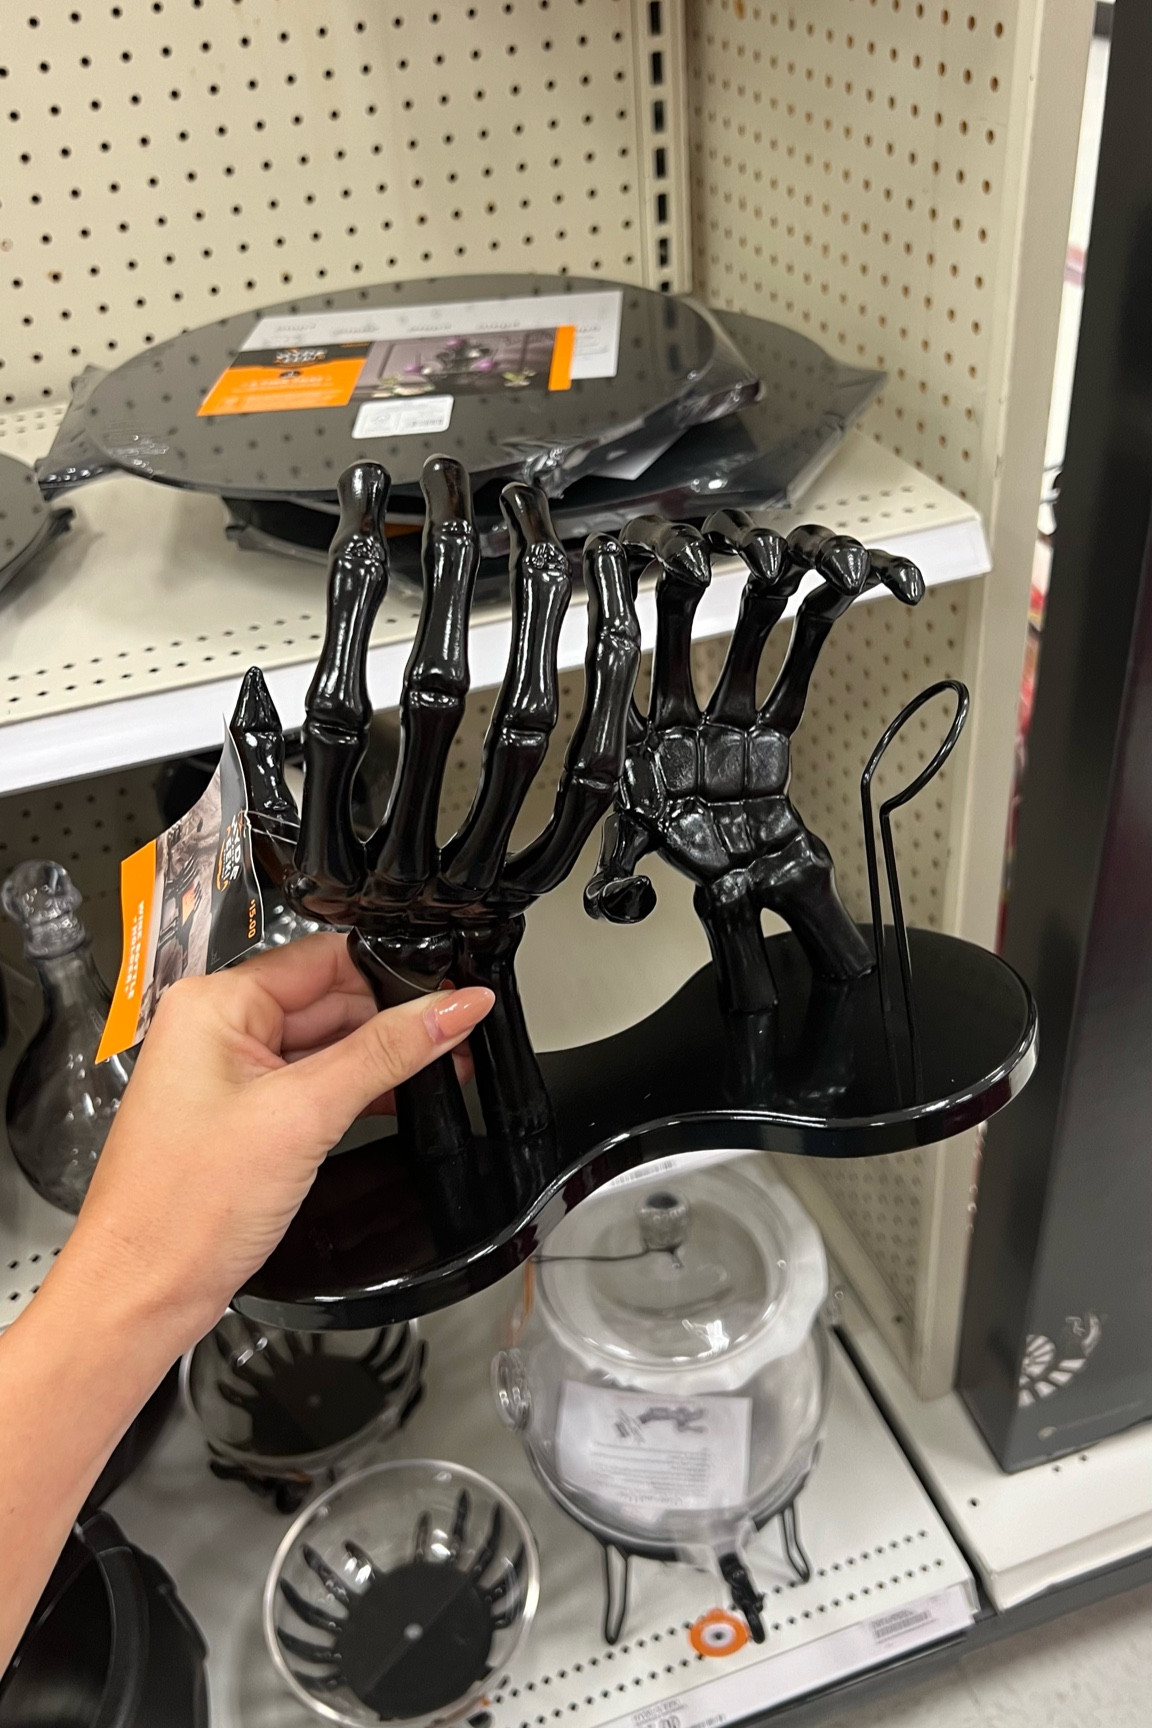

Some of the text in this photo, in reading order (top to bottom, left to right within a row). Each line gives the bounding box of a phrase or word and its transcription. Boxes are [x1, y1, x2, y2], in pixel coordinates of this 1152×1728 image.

[230, 815, 241, 881] HYDE
[128, 900, 145, 1000] WINE BOTTLE
[248, 898, 257, 939] $15.00
